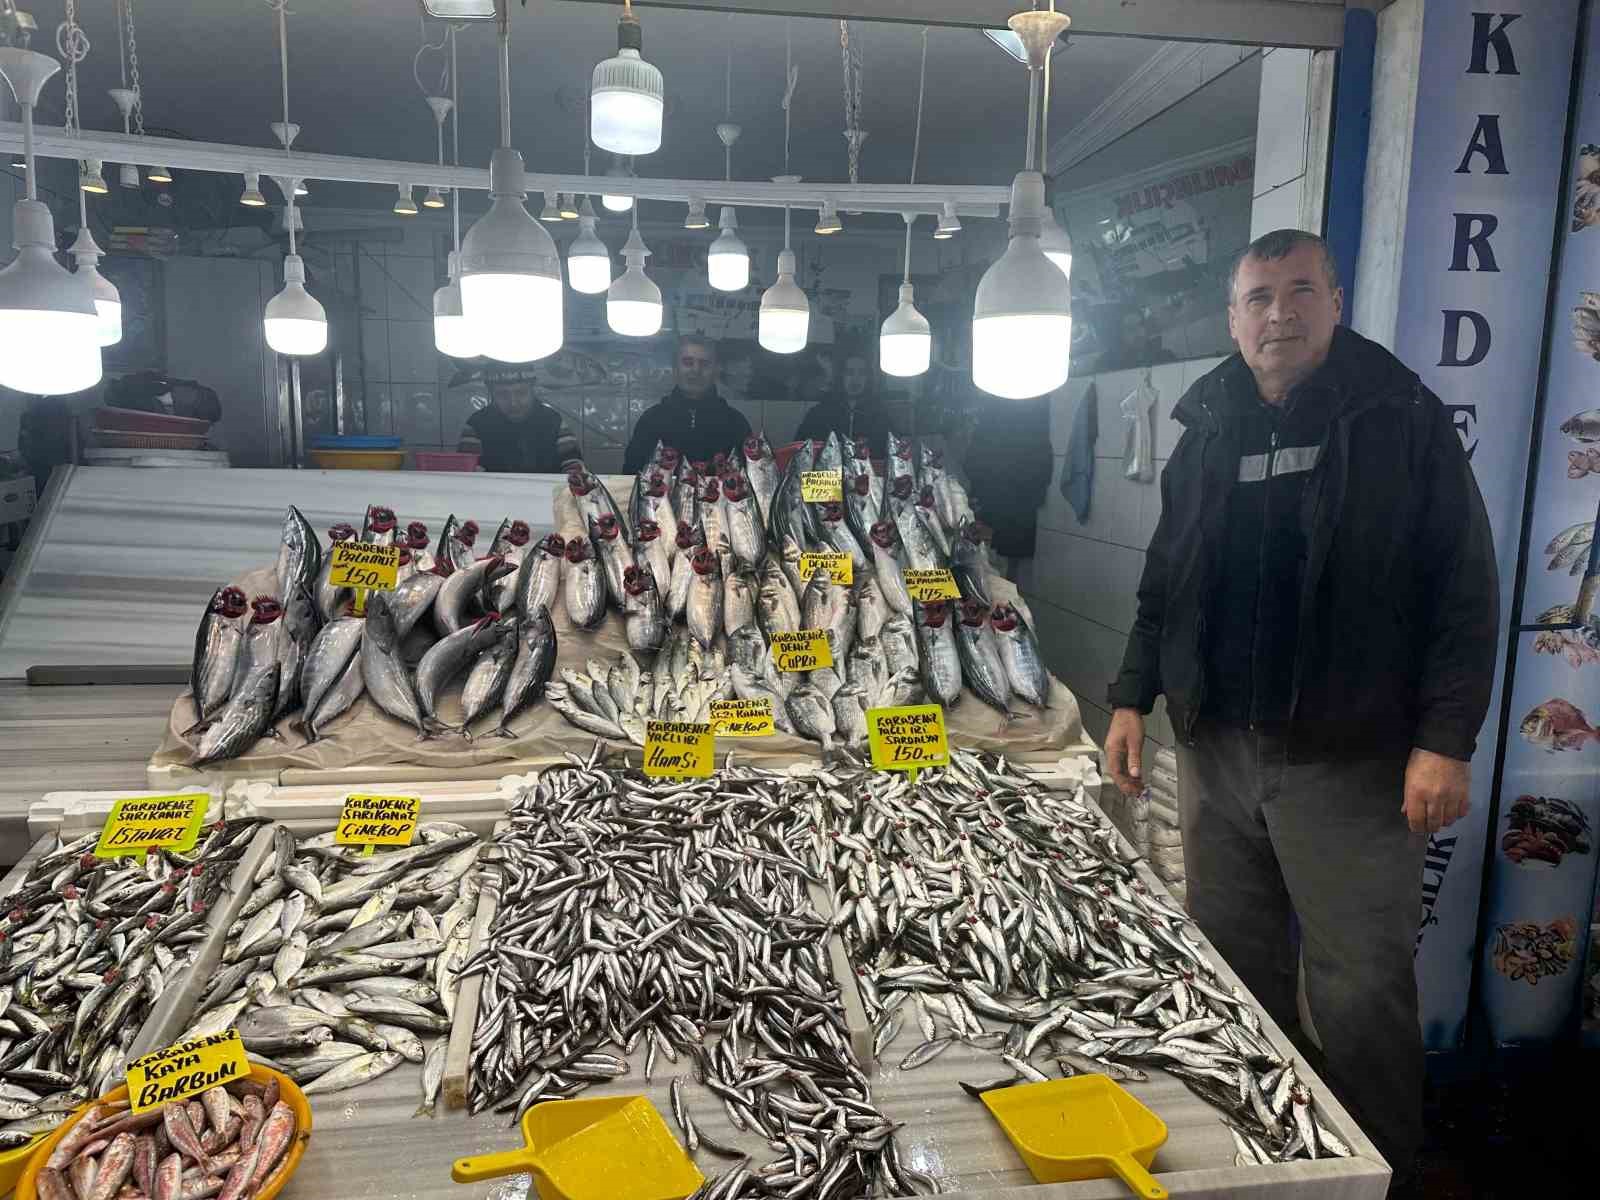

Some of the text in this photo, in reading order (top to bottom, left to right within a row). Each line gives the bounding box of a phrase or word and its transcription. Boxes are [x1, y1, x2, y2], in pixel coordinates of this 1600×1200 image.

[338, 566, 379, 586] 150
[803, 567, 848, 582] LEEK
[778, 653, 817, 671] ÇUPRA
[884, 735, 939, 745] SARDALYA
[891, 746, 923, 762] 150
[144, 1054, 200, 1081] KAYA
[138, 1061, 237, 1107] BARBUN
